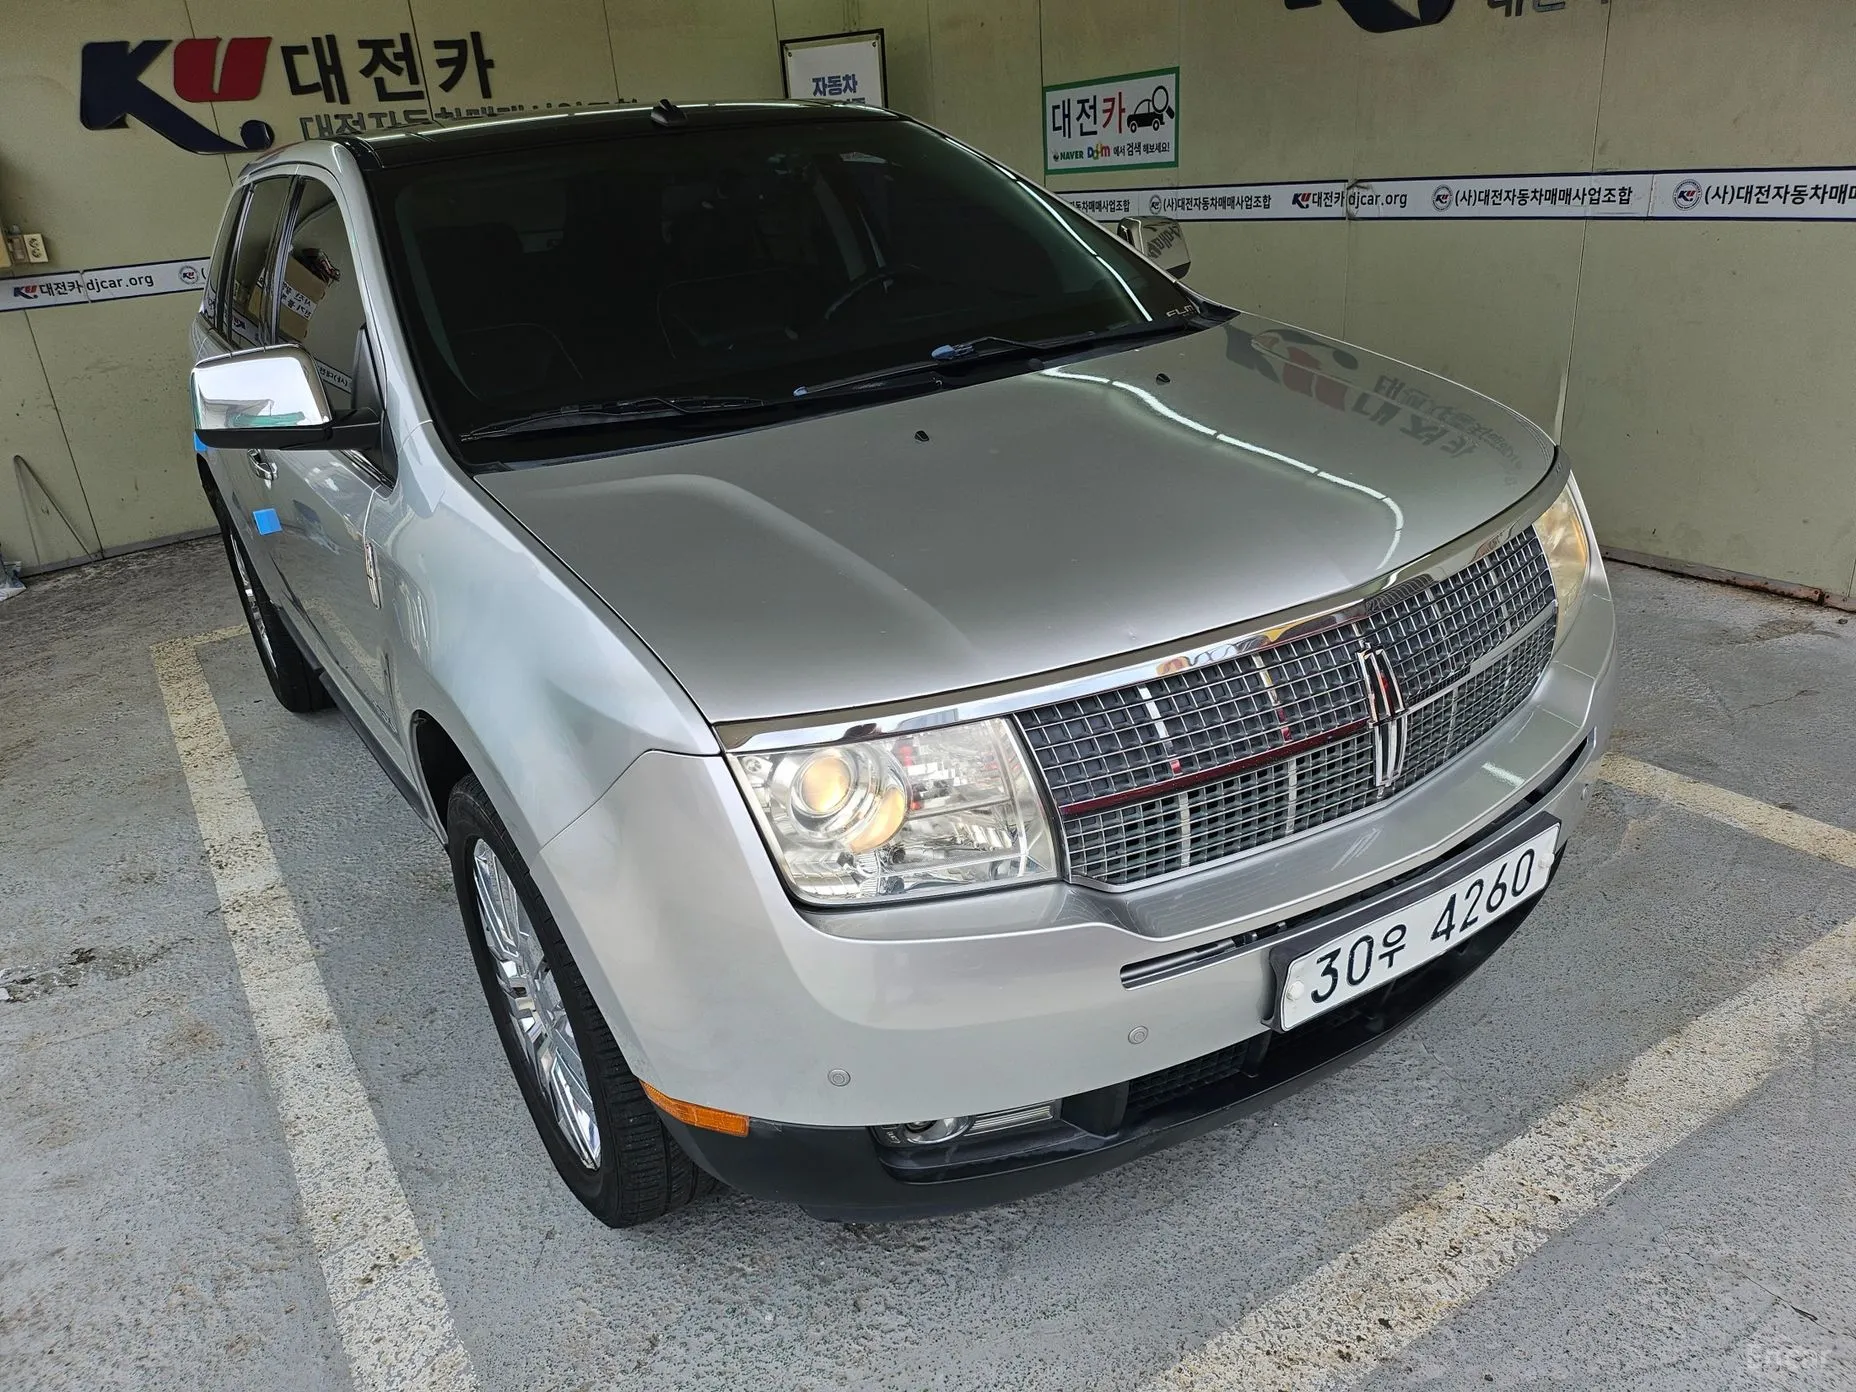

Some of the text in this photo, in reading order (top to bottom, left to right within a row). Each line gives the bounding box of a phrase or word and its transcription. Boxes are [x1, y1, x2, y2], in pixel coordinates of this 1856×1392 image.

[280, 31, 495, 105] 대전카
[812, 74, 858, 96] 자동차
[1052, 91, 1126, 138] 대전카
[1060, 150, 1084, 160] NAVER
[1113, 145, 1126, 156] 에서
[1127, 142, 1142, 156] 검색
[1143, 142, 1170, 155] 해보세요!
[1312, 190, 1345, 208] 대전카
[1348, 191, 1408, 209] djcar.org
[1455, 186, 1633, 207] (사)대전자동차매매사업조합
[40, 280, 84, 297] 대전카
[86, 274, 154, 292] djcar.org
[1310, 848, 1535, 1003] 30우 4260
